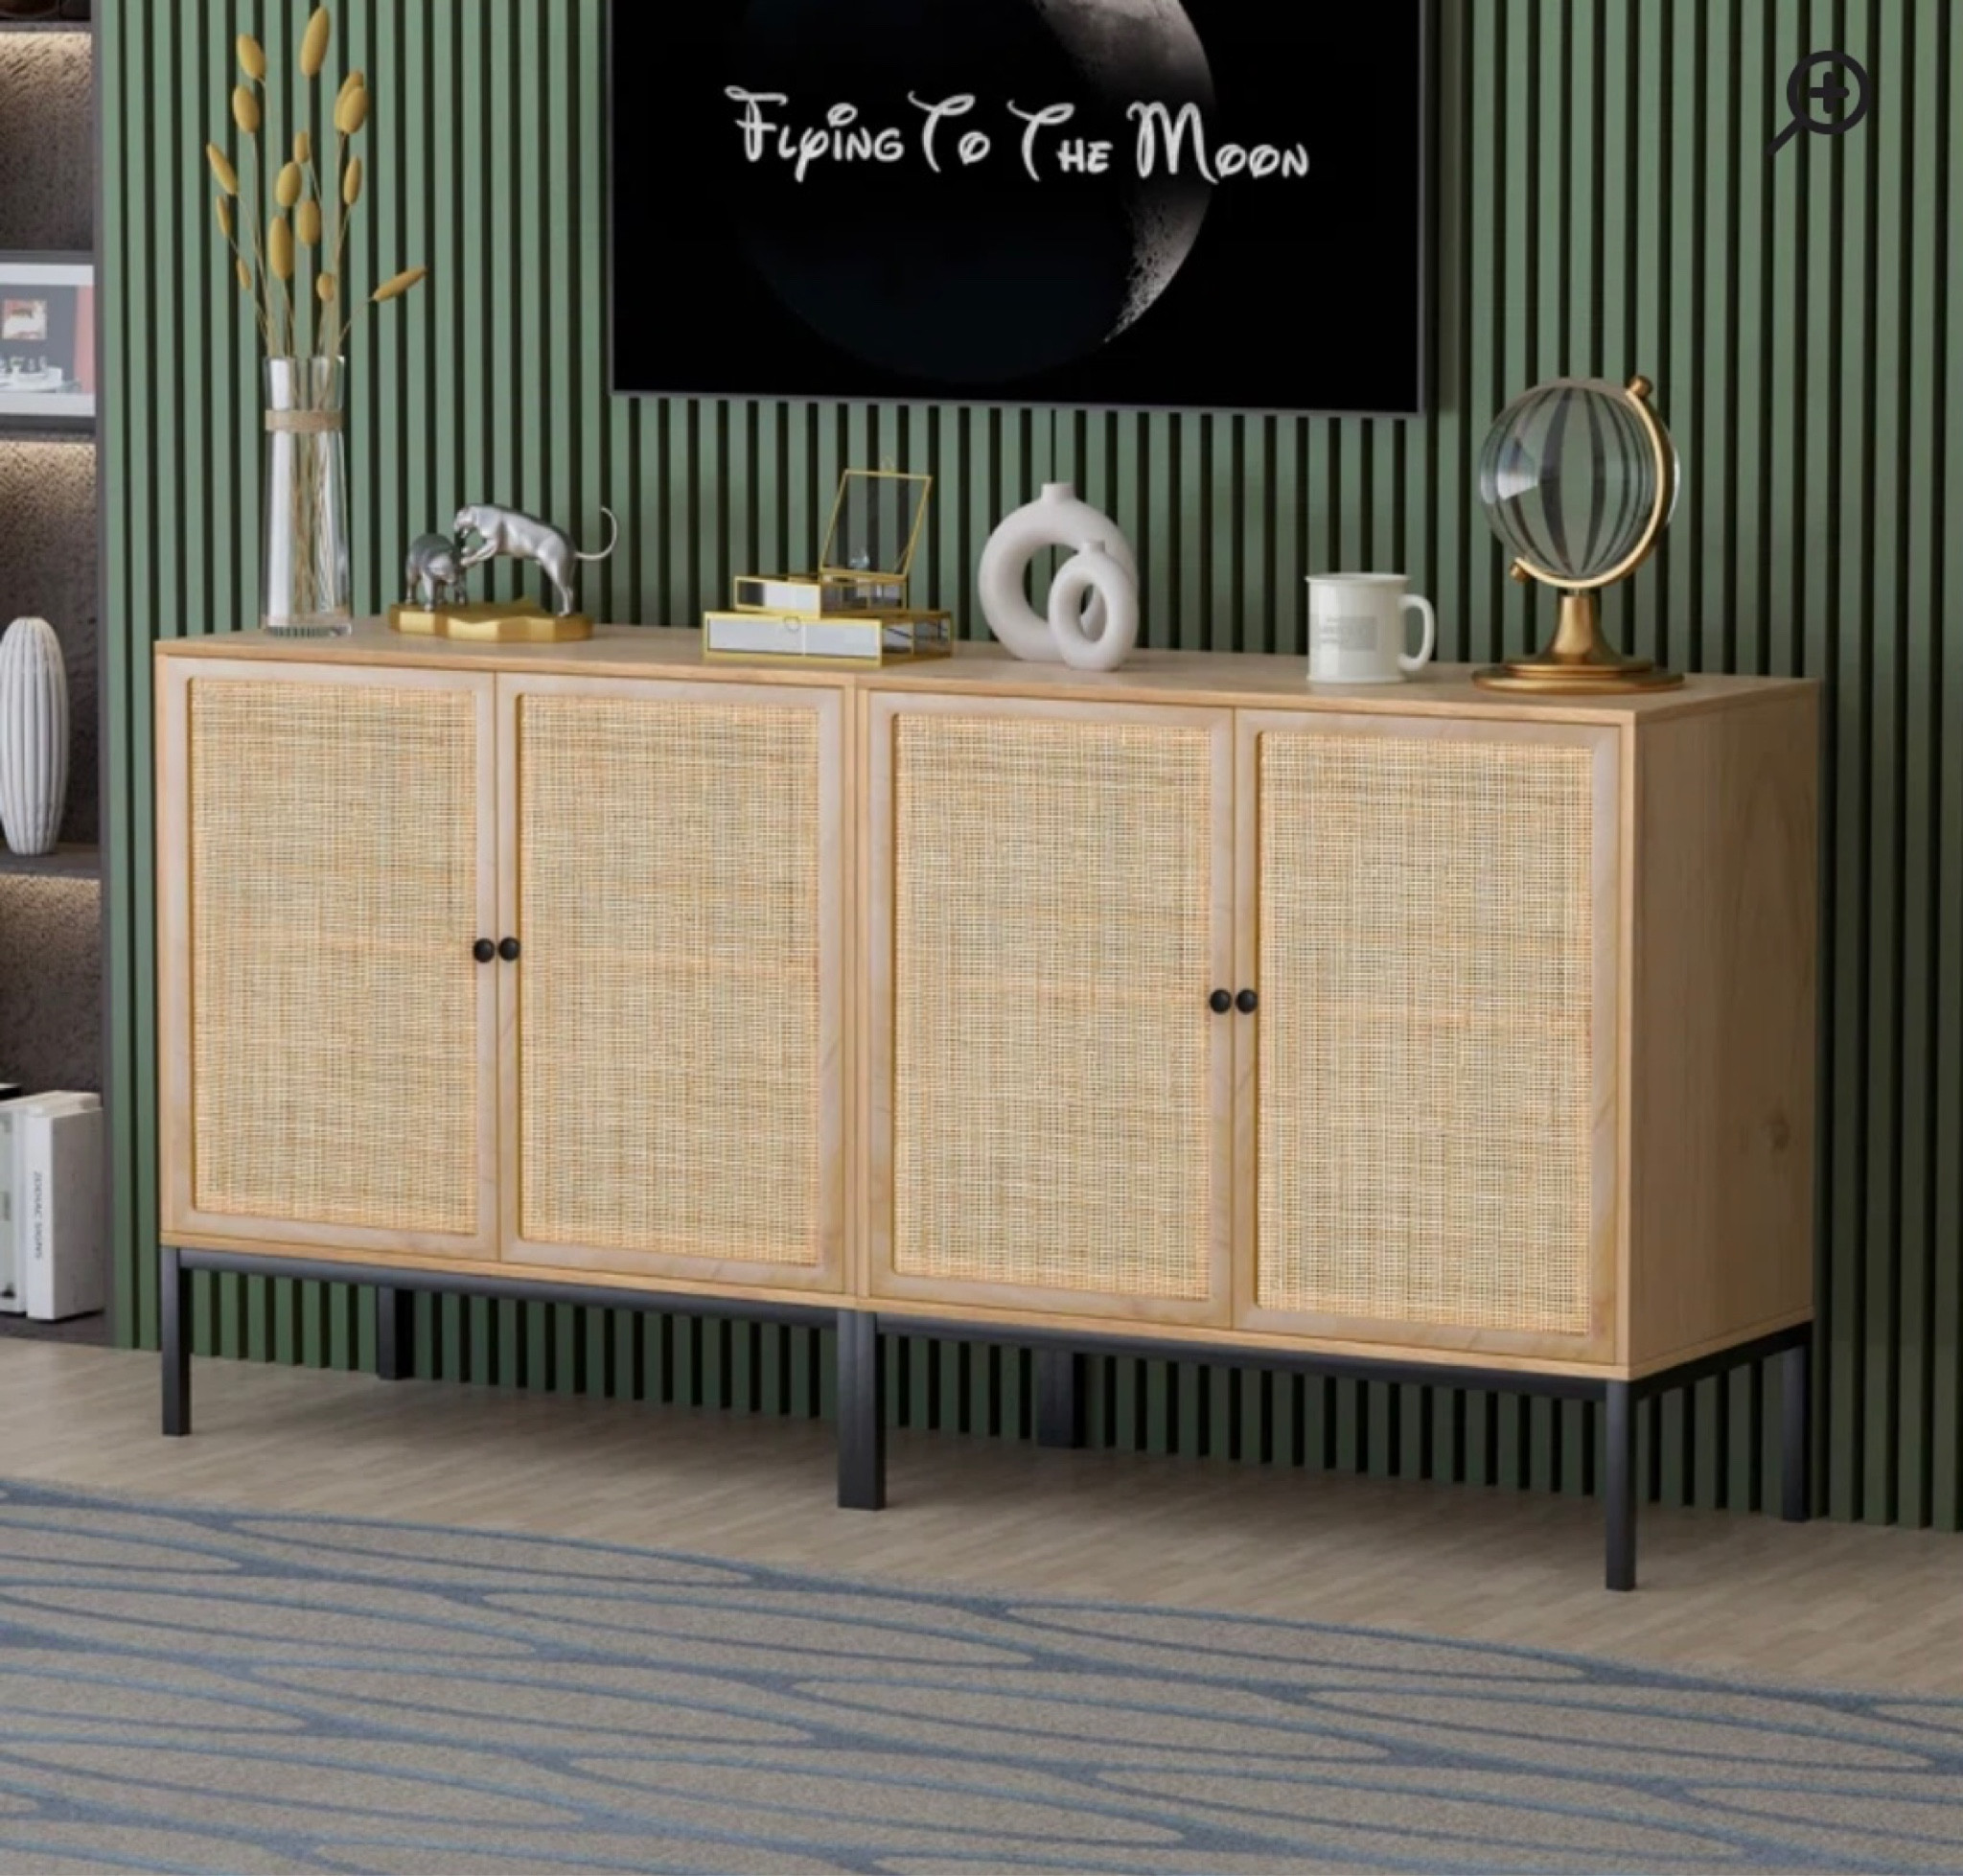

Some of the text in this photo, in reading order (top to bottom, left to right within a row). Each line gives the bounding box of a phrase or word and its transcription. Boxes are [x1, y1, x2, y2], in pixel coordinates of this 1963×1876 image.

[908, 90, 990, 172] To
[1006, 98, 1112, 180] The
[1126, 102, 1308, 183] Moon
